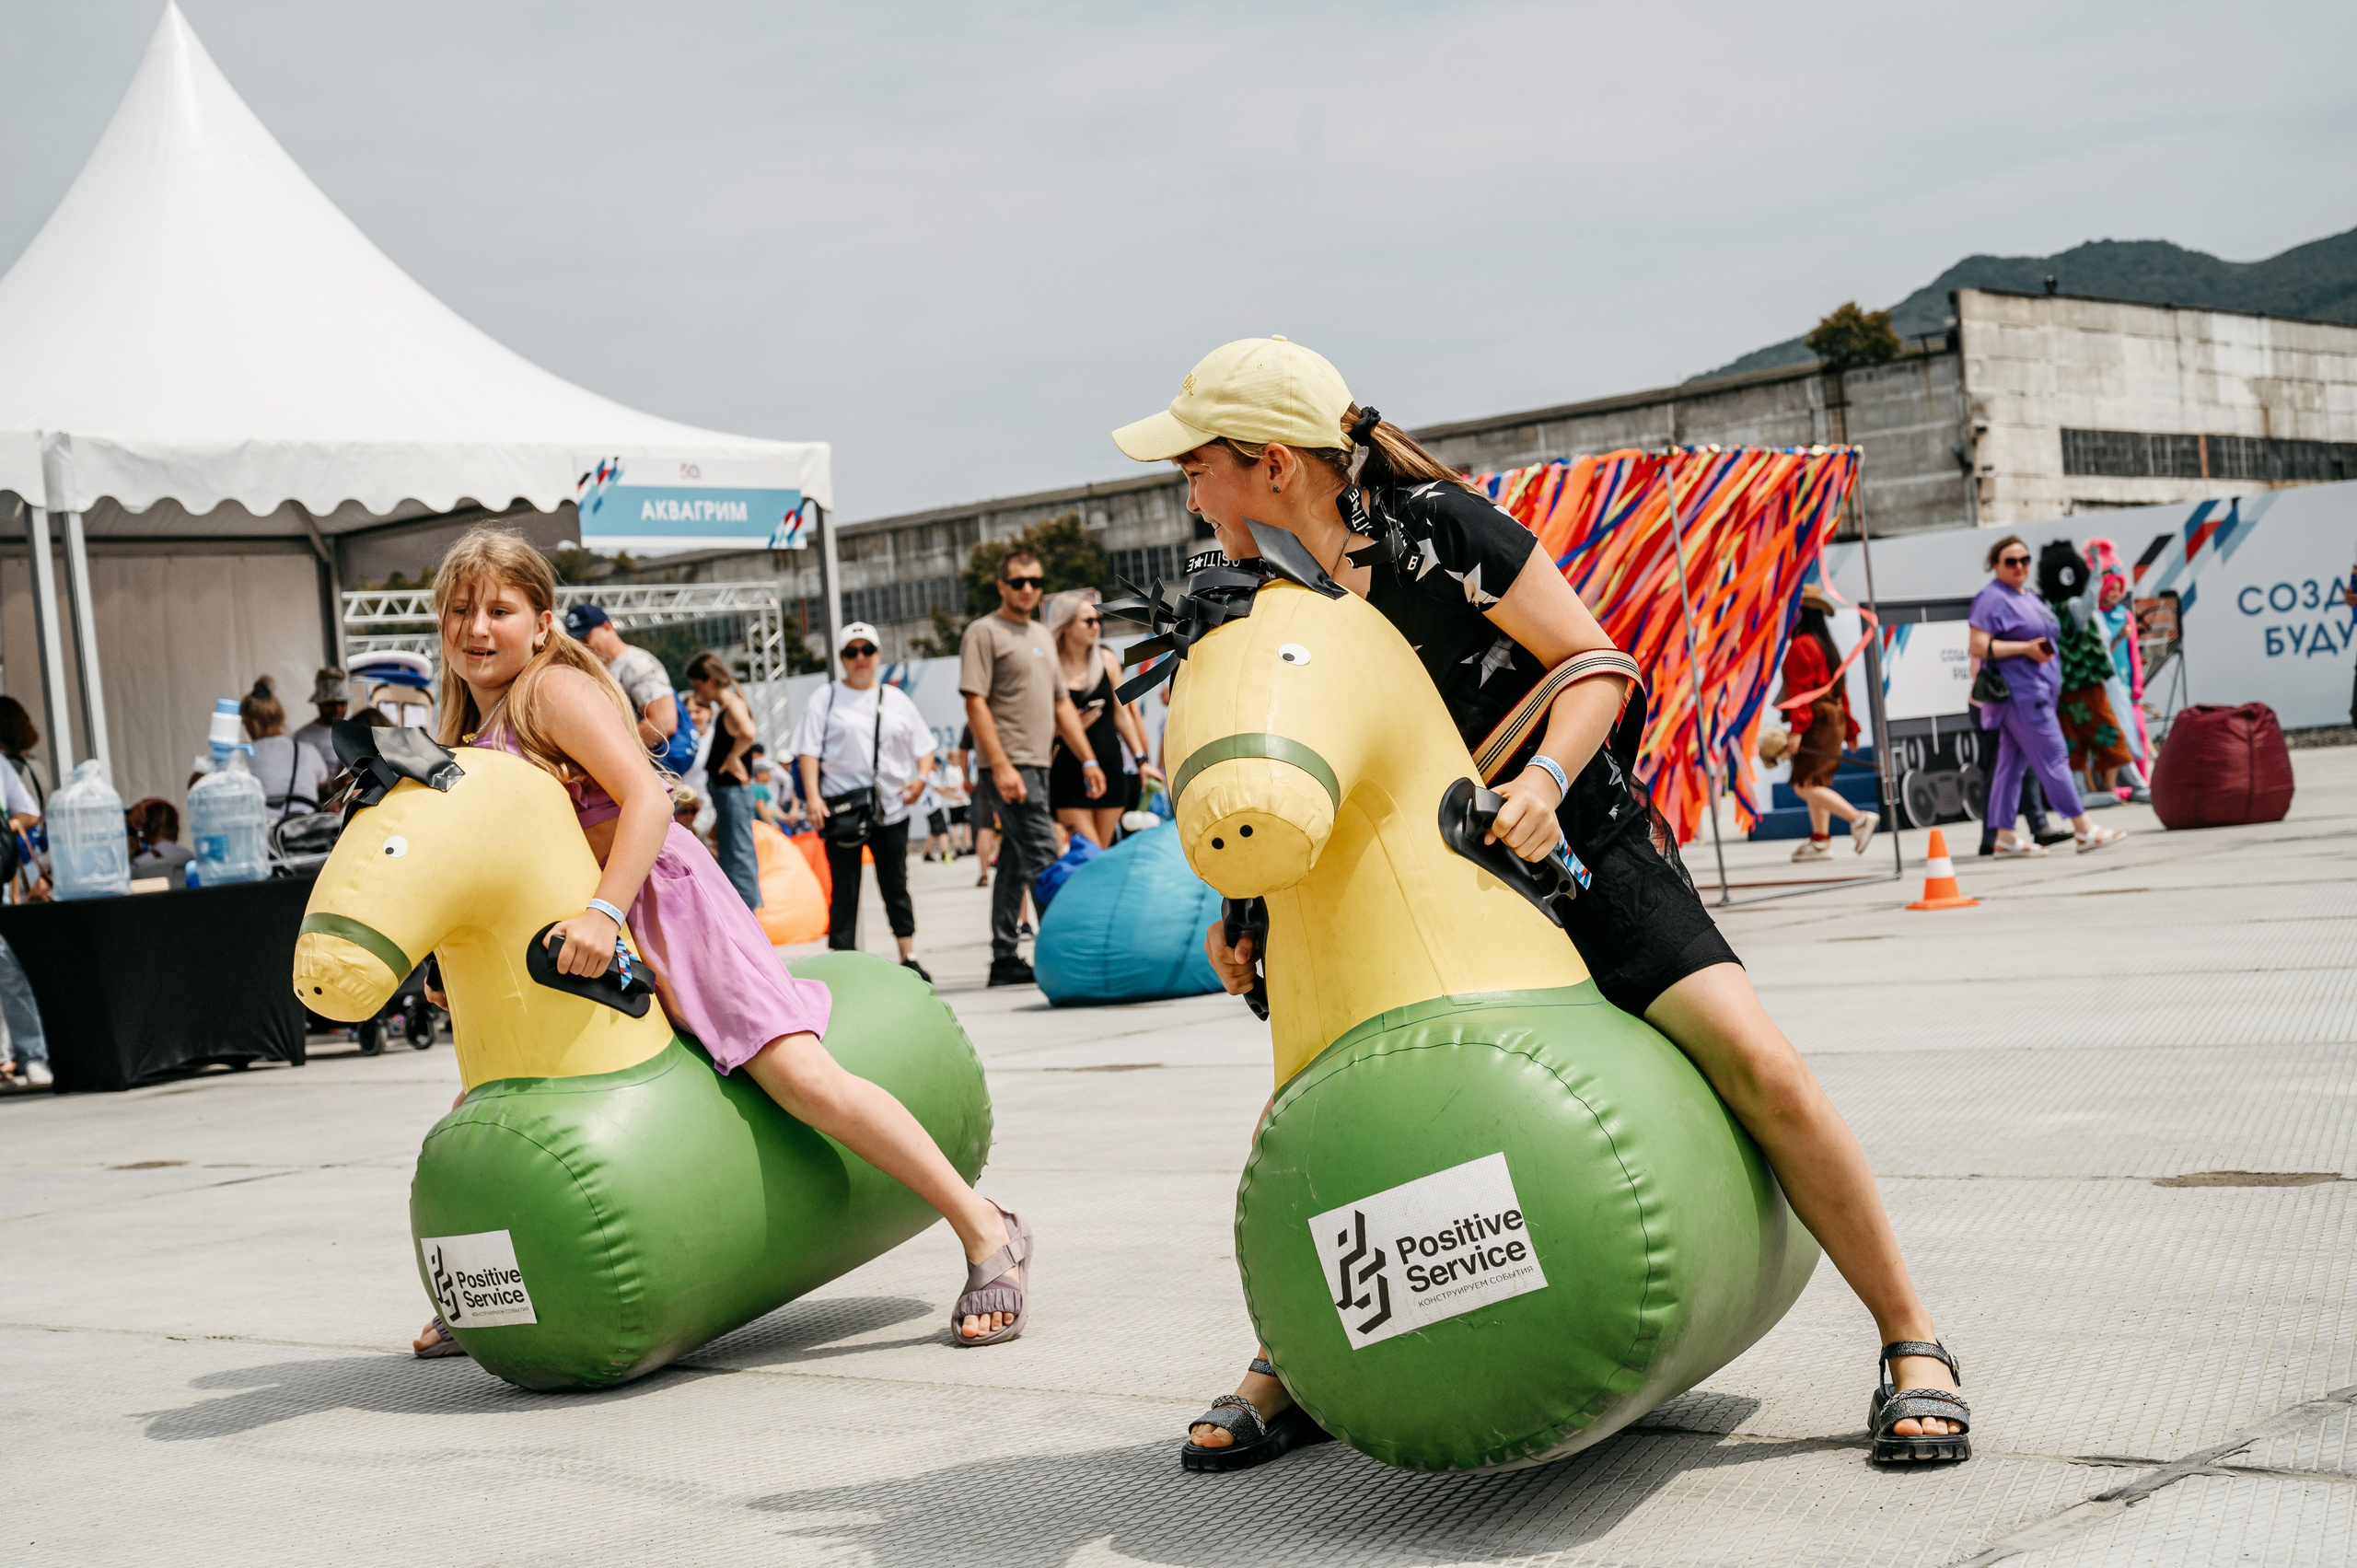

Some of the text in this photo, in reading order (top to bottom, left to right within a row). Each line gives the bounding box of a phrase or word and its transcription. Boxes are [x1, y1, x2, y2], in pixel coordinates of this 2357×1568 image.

[641, 499, 748, 522] АКВАГРИМ
[1396, 1209, 1524, 1265] Positive
[456, 1267, 522, 1289] Positive
[1406, 1240, 1527, 1293] Service
[463, 1288, 525, 1308] Service
[1418, 1265, 1534, 1307] КОНСТРУИРУЕМ СОБЫТИЯ
